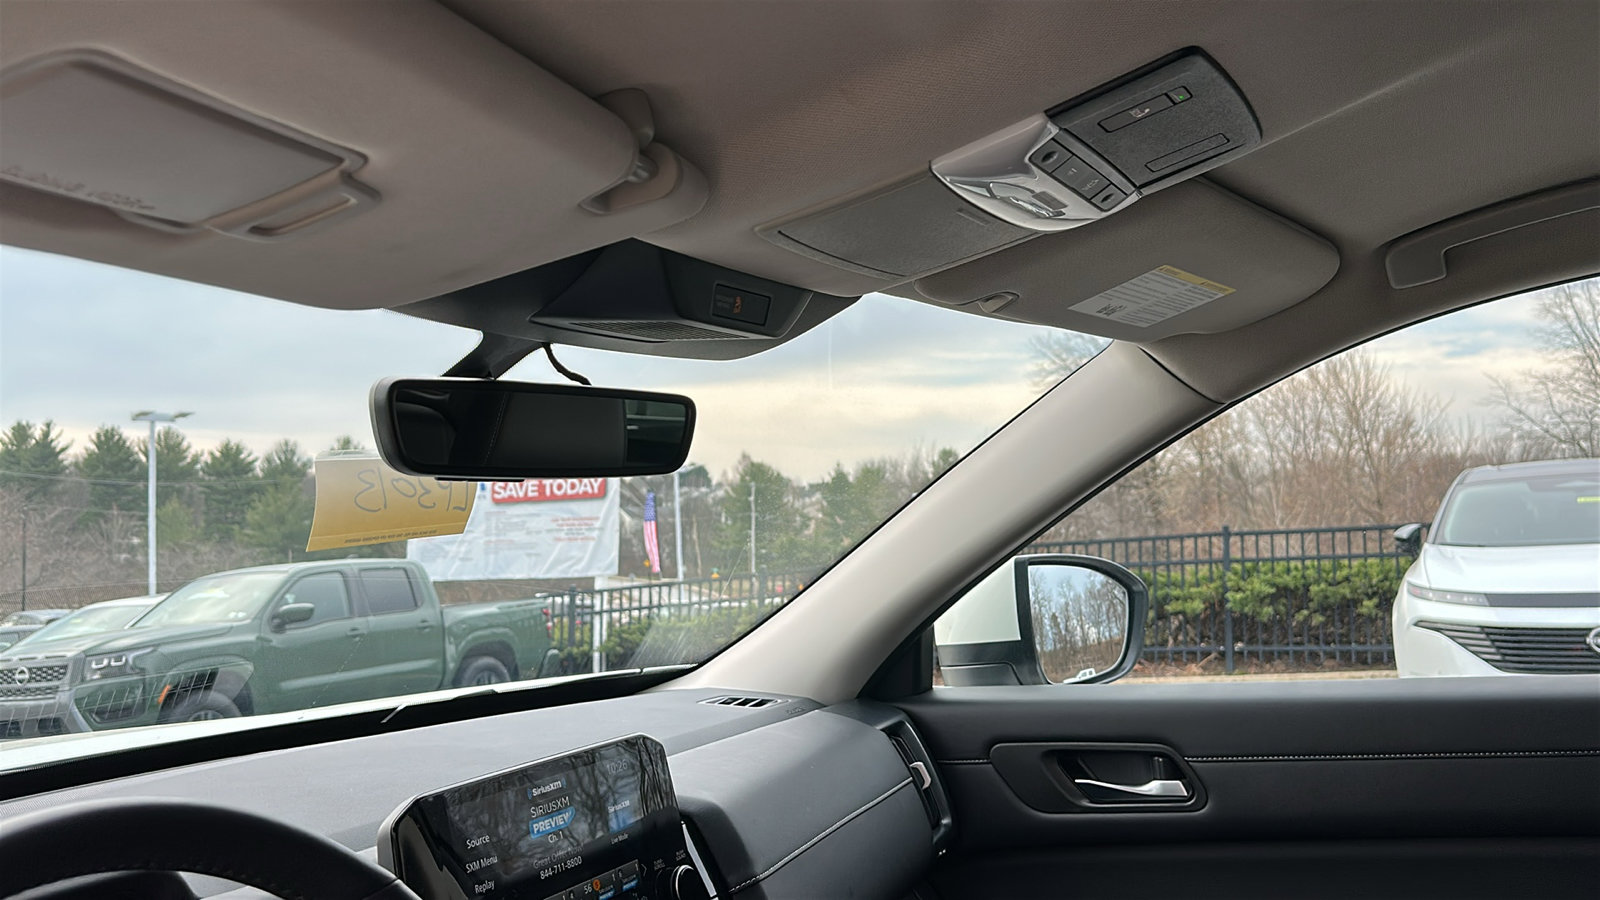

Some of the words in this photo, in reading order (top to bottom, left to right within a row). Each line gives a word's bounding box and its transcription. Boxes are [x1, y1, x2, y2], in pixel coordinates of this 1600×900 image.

[493, 480, 539, 499] SAVE
[543, 478, 600, 497] TODAY
[533, 811, 572, 834] PREVIEW
[466, 834, 490, 849] Source
[548, 833, 558, 843] Ch.
[465, 861, 480, 873] SXM
[480, 855, 498, 868] Menu
[540, 856, 582, 880] 844-711-8800
[474, 880, 495, 894] Replay
[584, 883, 592, 894] 56
